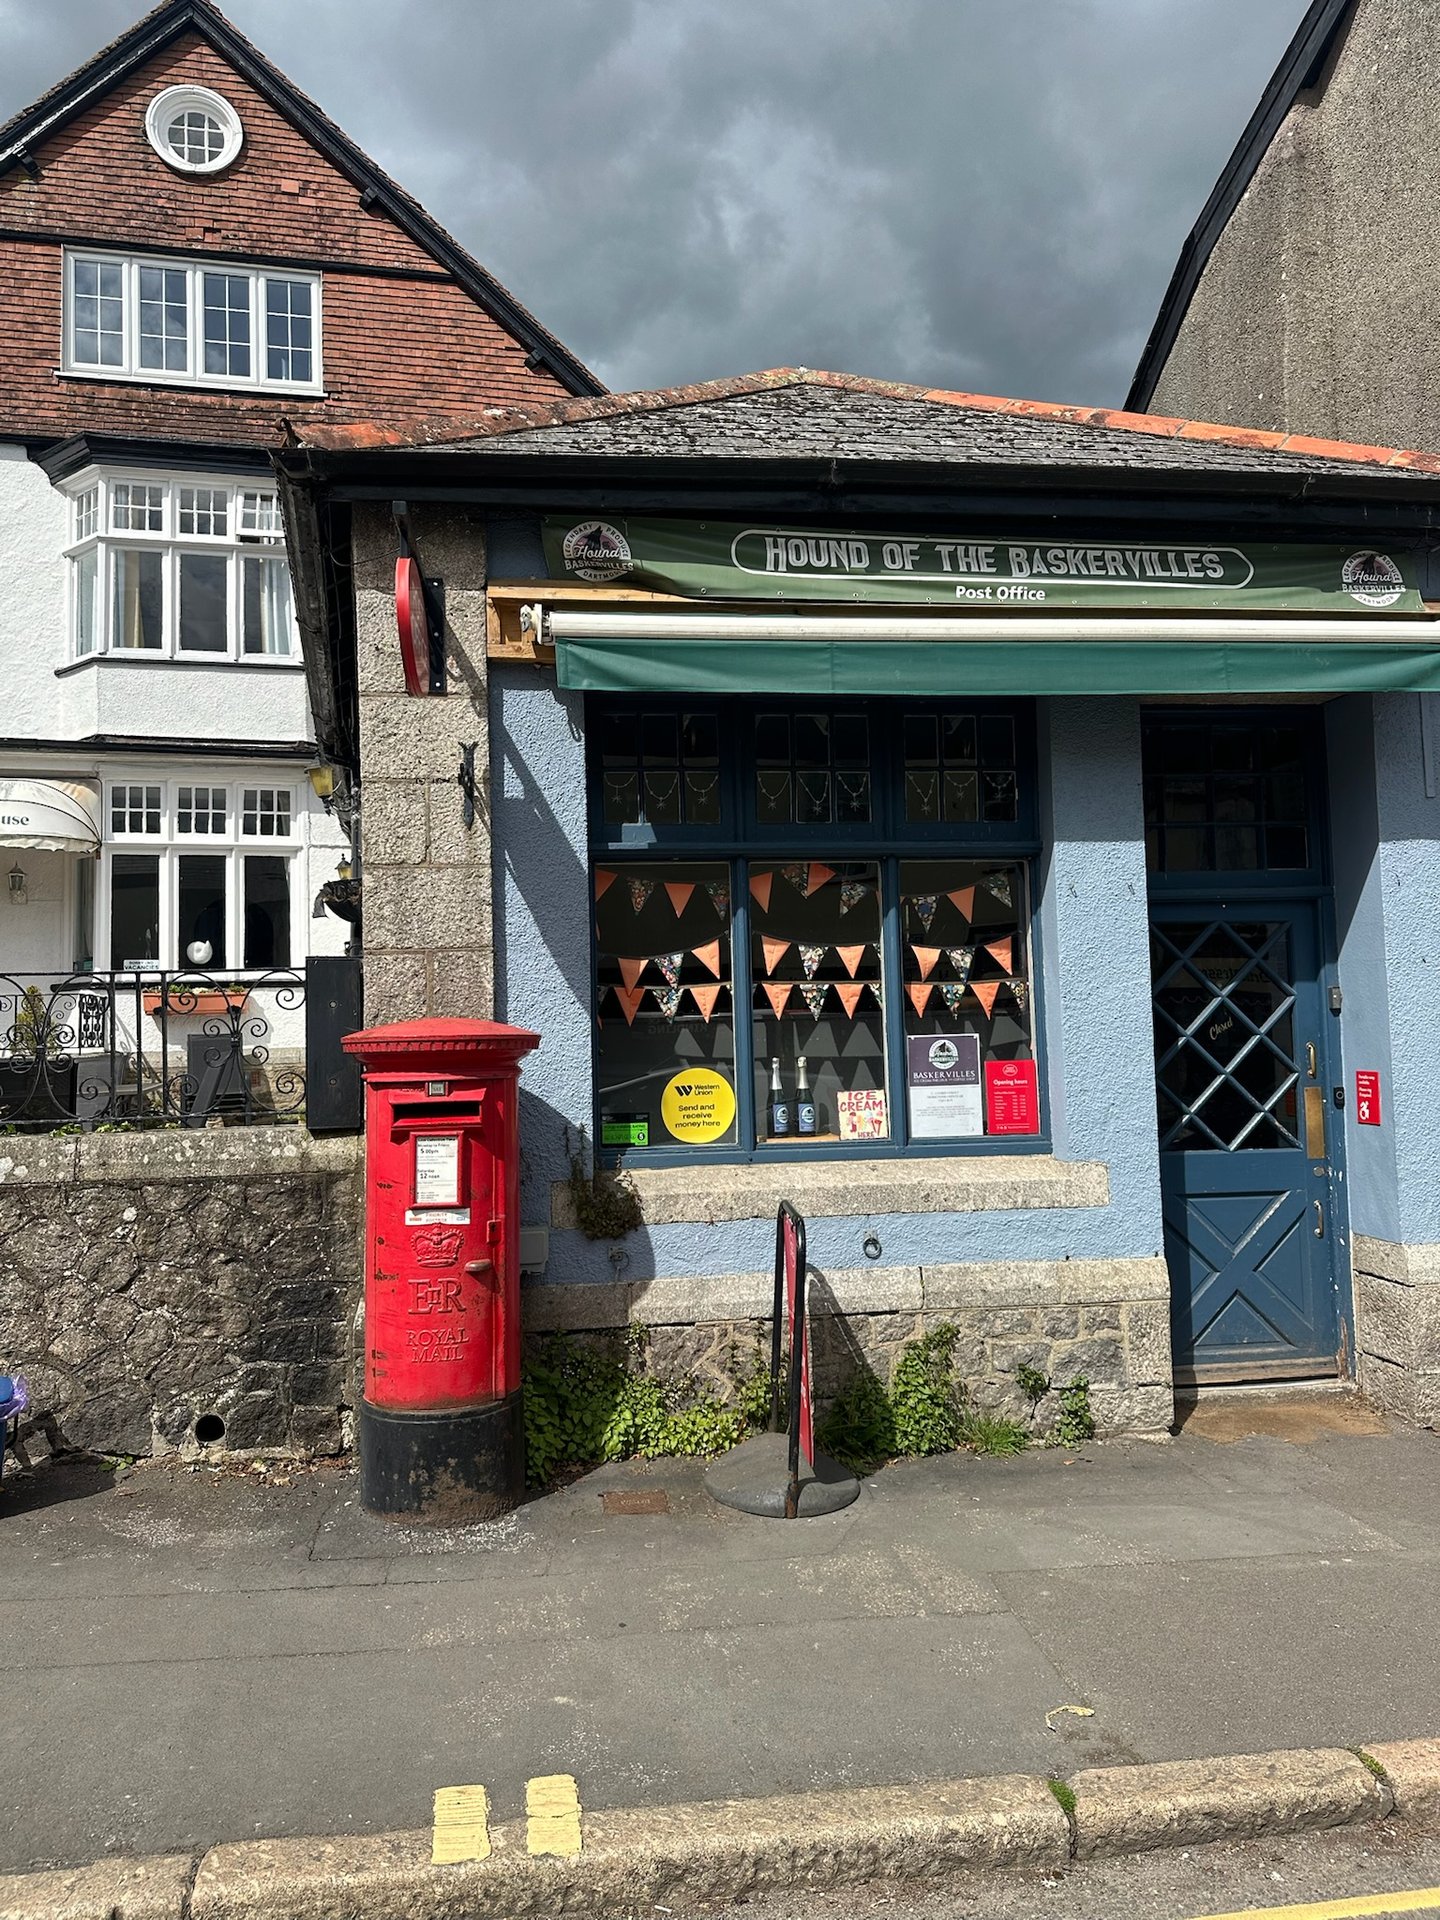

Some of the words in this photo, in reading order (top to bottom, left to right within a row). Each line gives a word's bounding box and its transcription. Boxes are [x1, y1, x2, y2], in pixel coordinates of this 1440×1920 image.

[564, 523, 593, 557] LEGENDARY
[605, 526, 630, 558] PRODUCE
[572, 545, 621, 560] Hound
[764, 536, 870, 572] HOUND
[883, 542, 920, 571] OF
[934, 544, 998, 573] THE
[1008, 546, 1225, 579] BASKERVILLES
[564, 559, 635, 572] BASKERVILLES
[1350, 569, 1393, 584] Hound
[955, 585, 992, 600] Post
[996, 585, 1046, 601] Office
[1341, 583, 1407, 594] BASKERVILLES
[912, 1070, 976, 1079] BASKERVILLES
[993, 1079, 1014, 1087] Opening
[847, 1091, 877, 1101] ICE
[678, 1104, 699, 1112] Send
[840, 1101, 883, 1112] CREAM
[675, 1121, 702, 1129] money
[857, 1130, 875, 1138] HERE
[405, 1328, 470, 1347] ROYAL
[411, 1345, 464, 1364] MAIL
